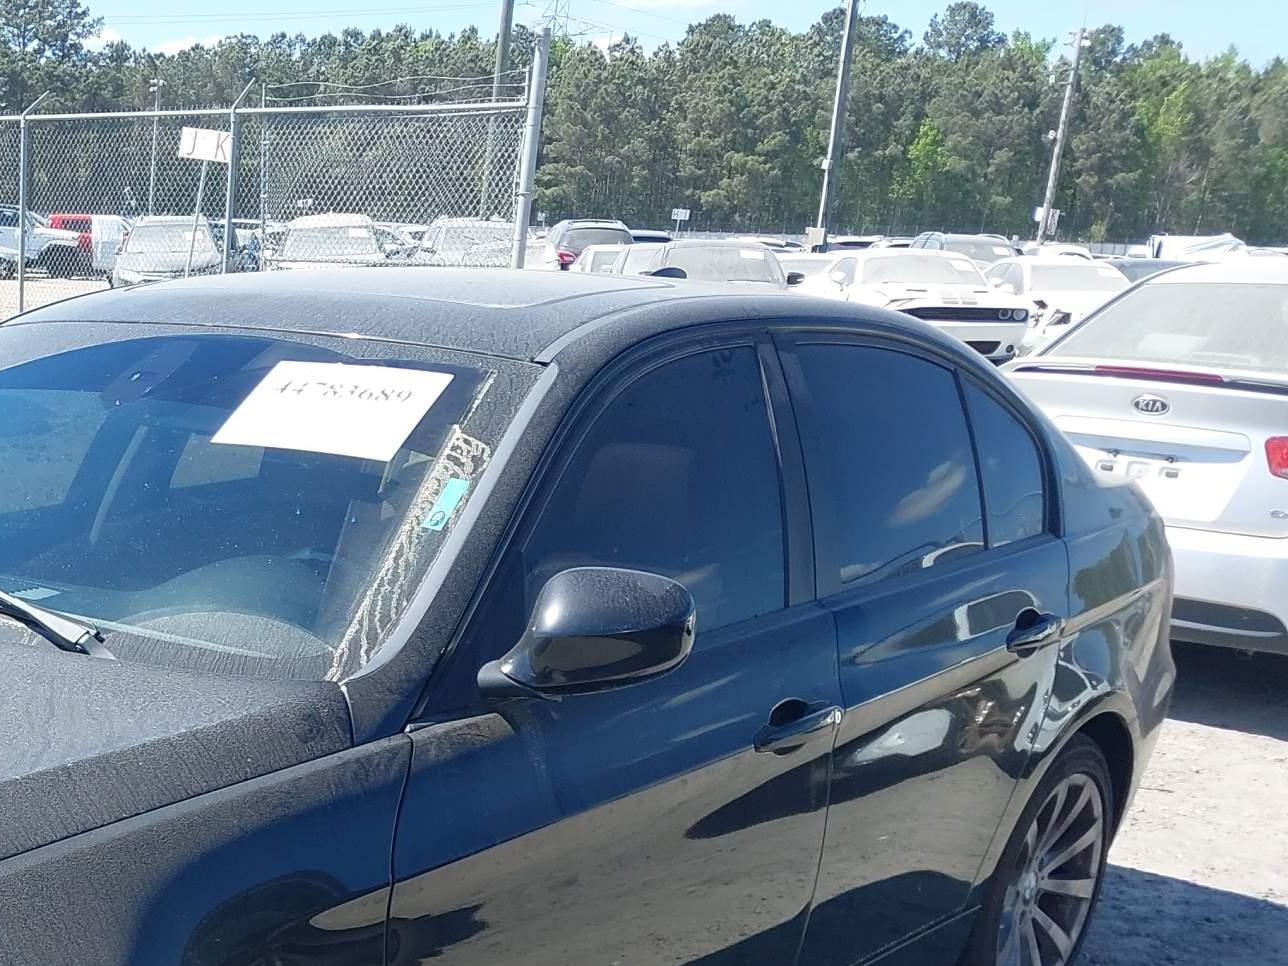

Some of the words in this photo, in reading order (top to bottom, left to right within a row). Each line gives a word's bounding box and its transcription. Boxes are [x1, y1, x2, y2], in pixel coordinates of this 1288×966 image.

[186, 130, 198, 156] J
[214, 133, 230, 160] K
[1138, 399, 1162, 412] KIA
